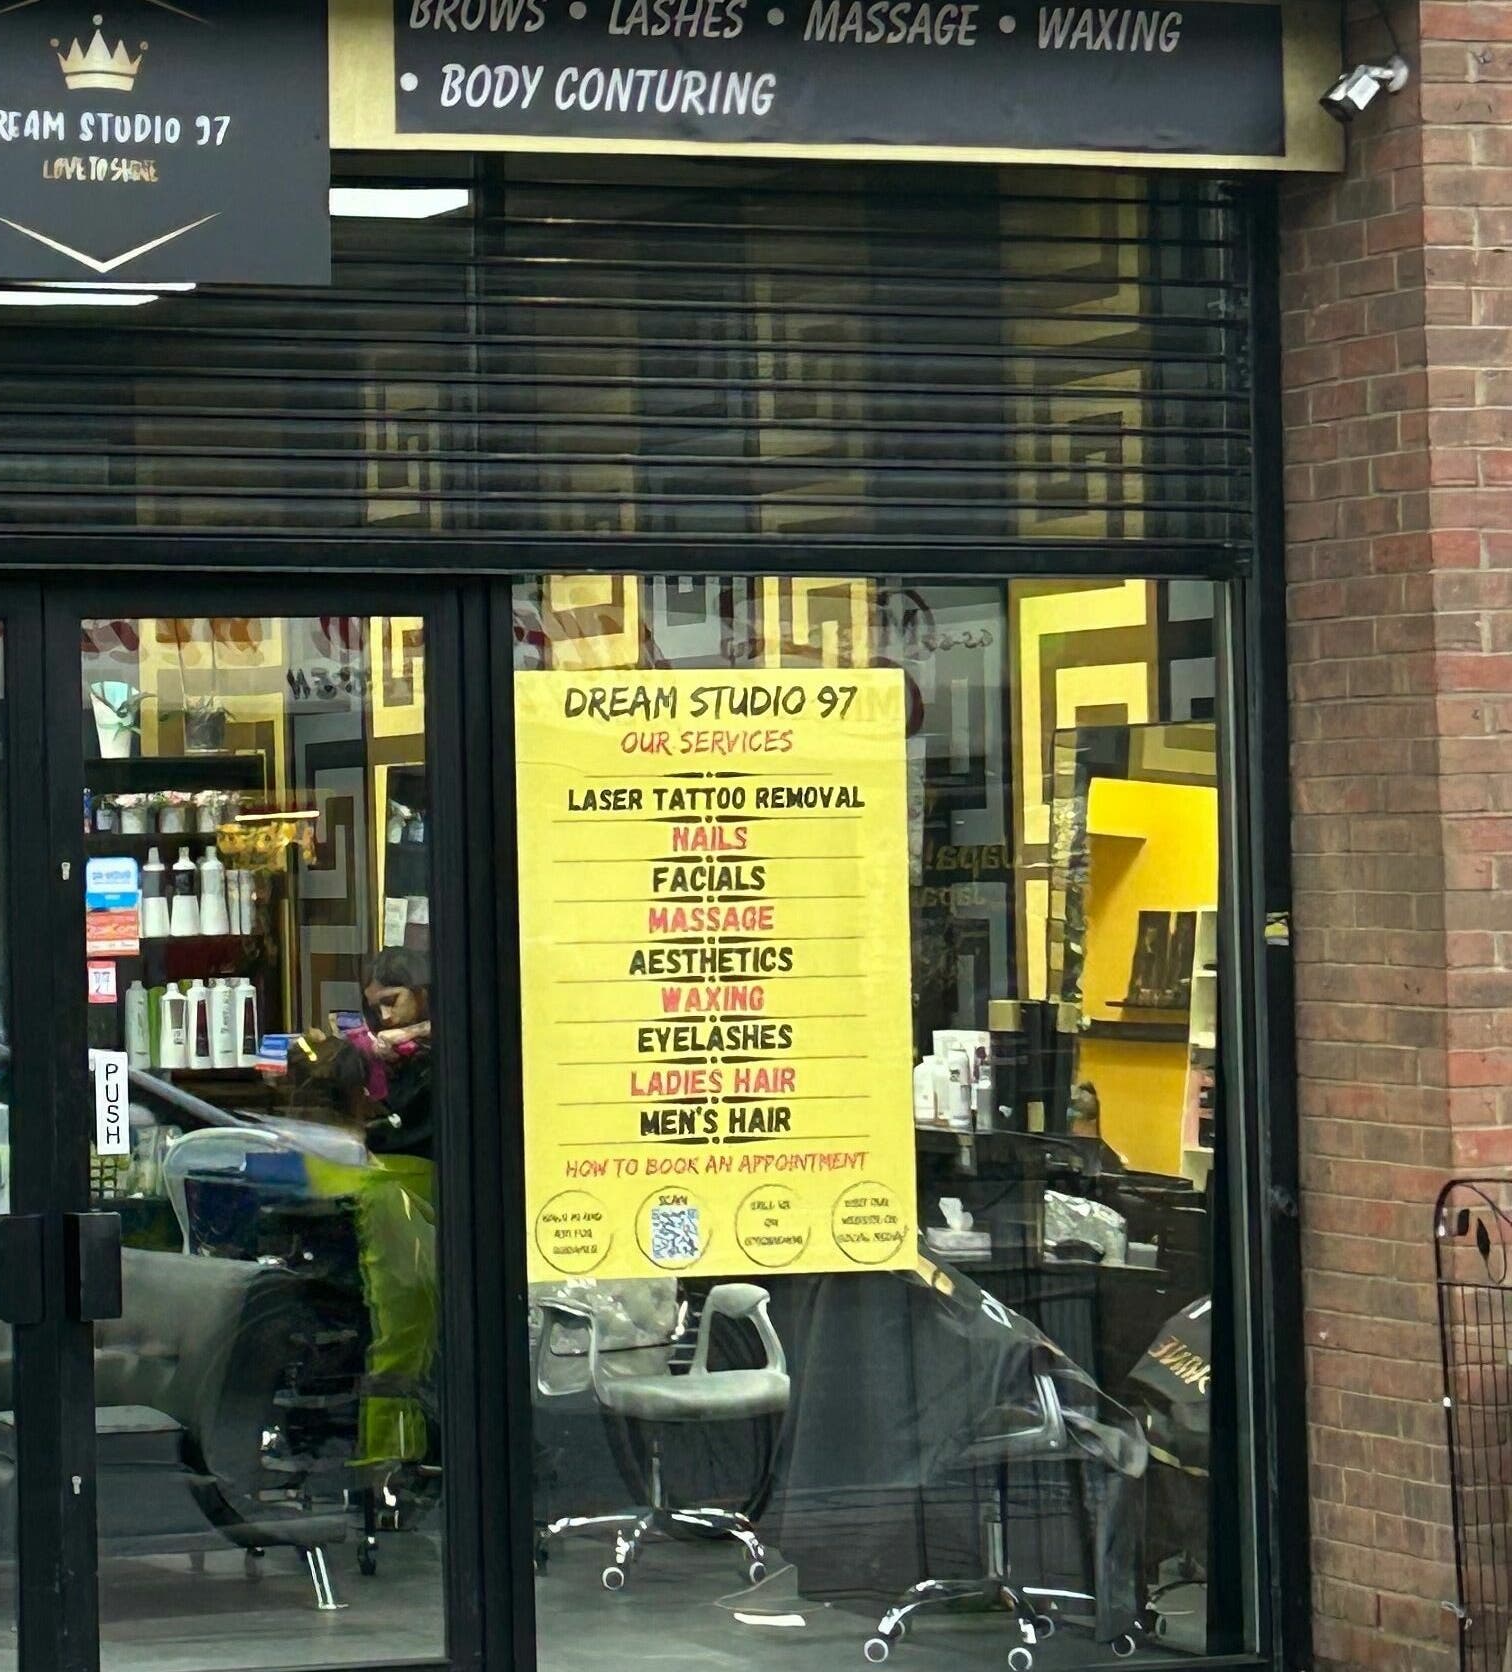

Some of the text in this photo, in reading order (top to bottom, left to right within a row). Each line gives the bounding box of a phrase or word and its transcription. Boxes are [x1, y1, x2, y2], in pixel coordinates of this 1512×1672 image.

[409, 0, 1183, 53] BROWS LASHES MASSAGE WAXING
[440, 63, 777, 116] BODY CONTURING
[79, 112, 182, 144] STUDIO
[194, 115, 231, 146] 97
[564, 685, 858, 722] DREAM STUDIO 97
[621, 729, 794, 755] OUR SERVICES
[568, 785, 866, 812] LASER TATTOO REMOVAL
[672, 825, 748, 852] NAILS
[652, 865, 766, 892] FACIALS
[648, 904, 775, 934] MASSAGE
[628, 946, 794, 976] AESTHETICS
[661, 984, 765, 1013] WAXING
[637, 1024, 794, 1054] EYELASHES
[630, 1067, 797, 1097] LADIES HAIR
[105, 1063, 121, 1145] PUSH
[640, 1106, 792, 1137] MEN'S HAIR
[565, 1151, 870, 1179] HOW TO BOOK AN APPOINTMENT
[658, 1195, 689, 1207] SCAN
